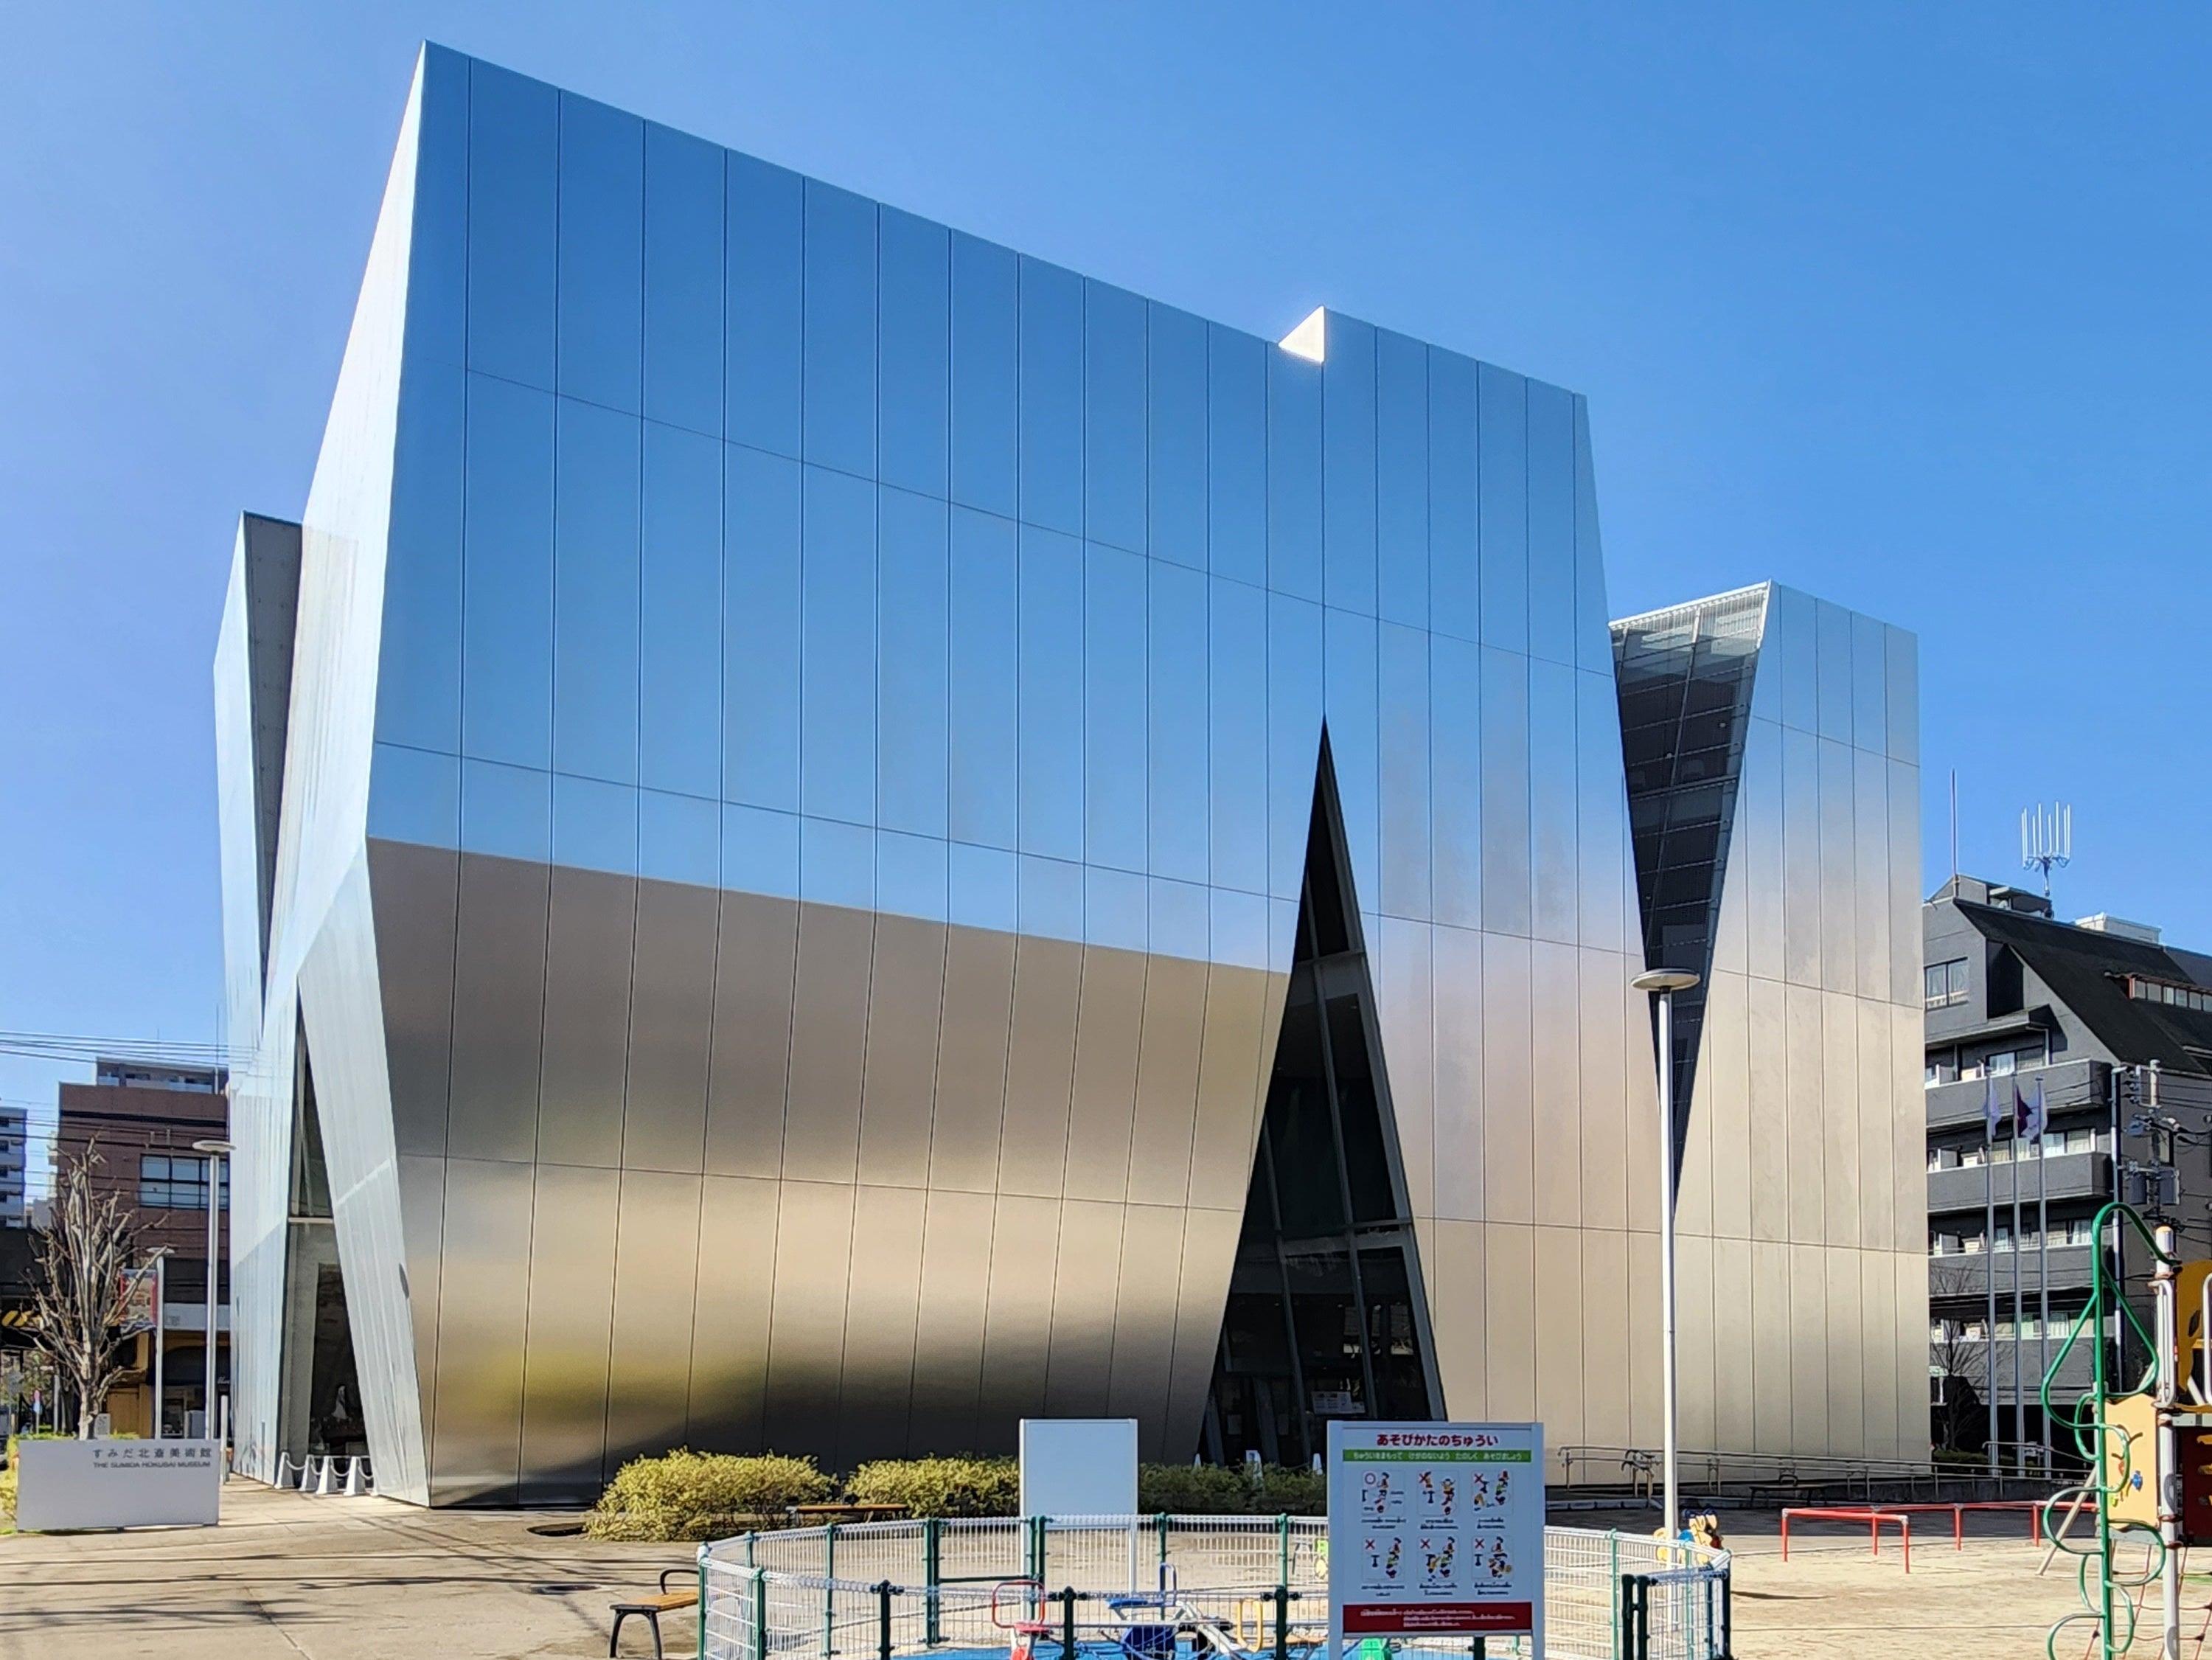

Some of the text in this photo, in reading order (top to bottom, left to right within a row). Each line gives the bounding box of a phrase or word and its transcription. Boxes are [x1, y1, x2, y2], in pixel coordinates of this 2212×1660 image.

[1377, 1434, 1498, 1446] あそびかたのちゅうい
[93, 1448, 212, 1458] すみだ北斎美術館
[1354, 1451, 1402, 1459] ちゅういをまもって
[1455, 1452, 1478, 1460] たのしく
[1484, 1452, 1521, 1460] あそびましょう
